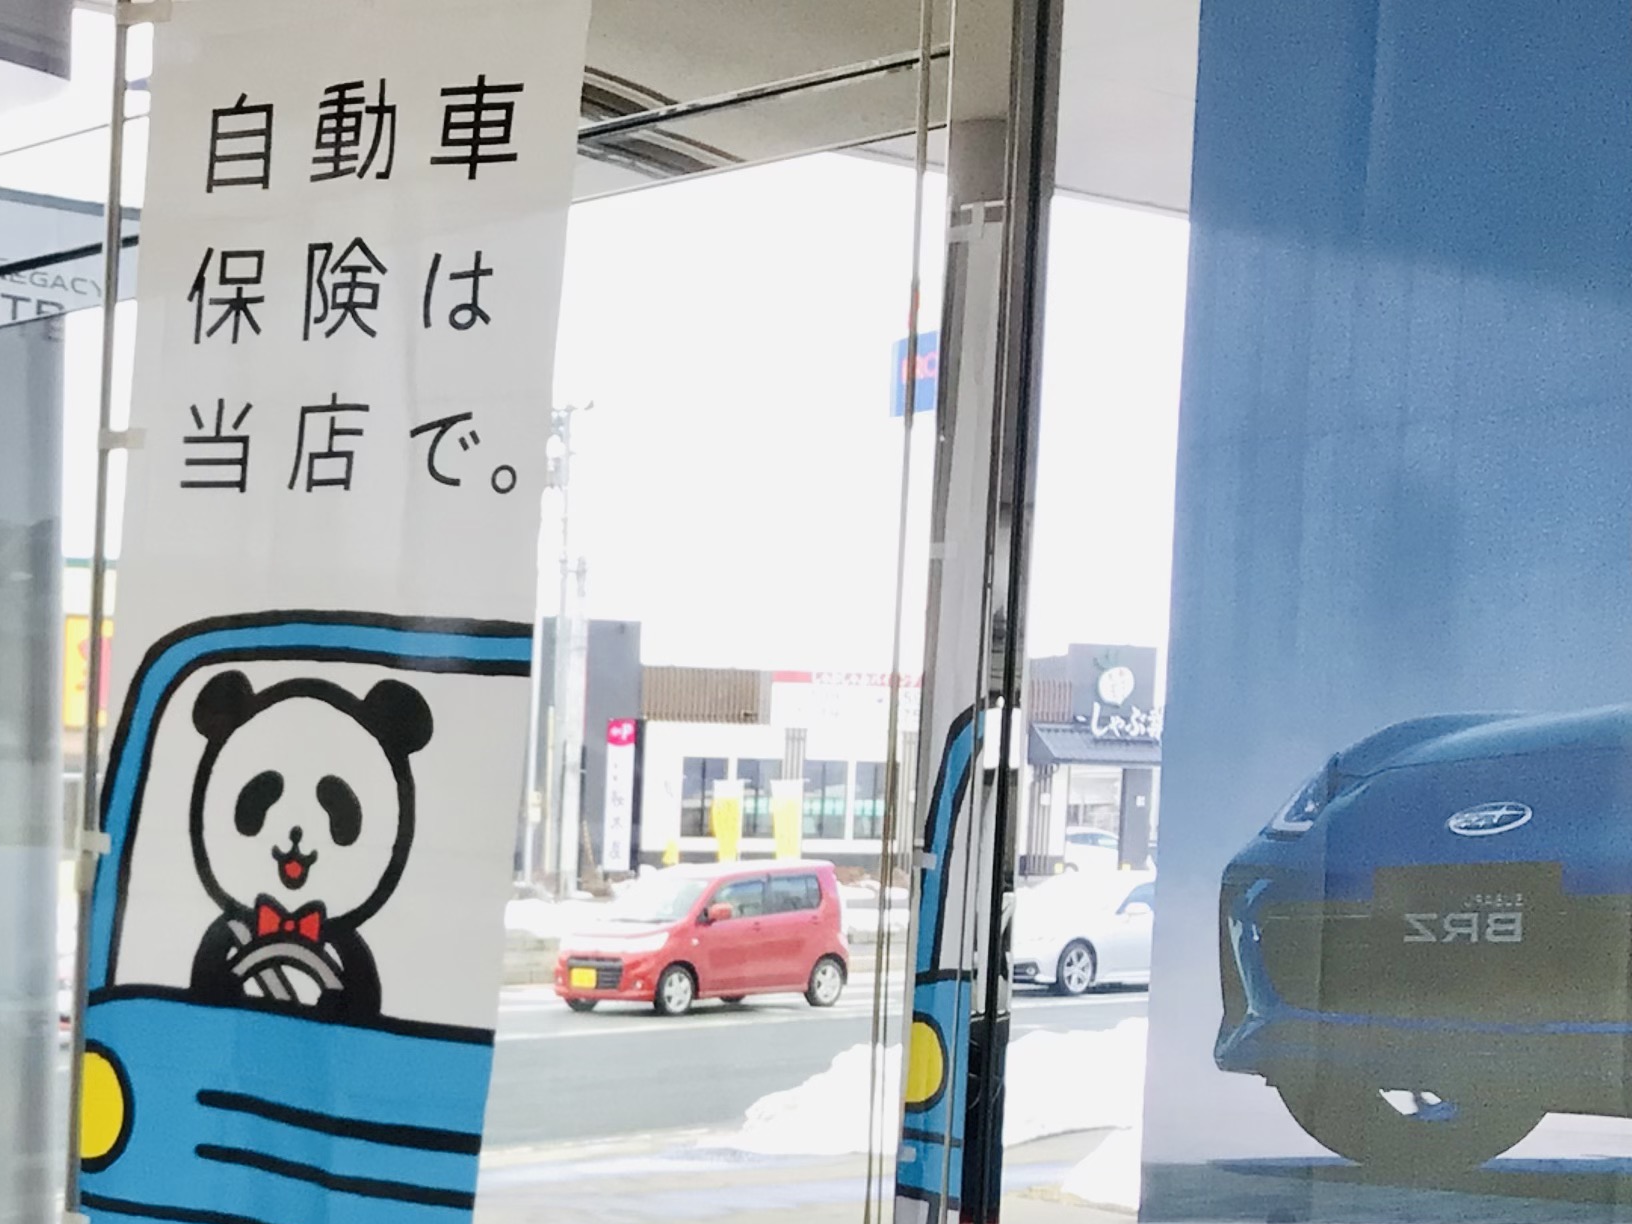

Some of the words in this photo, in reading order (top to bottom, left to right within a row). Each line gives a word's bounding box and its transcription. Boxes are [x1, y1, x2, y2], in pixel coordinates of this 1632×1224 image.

[206, 74, 524, 194] 自動車
[187, 236, 494, 345] 保険は
[180, 392, 517, 494] 当店で。
